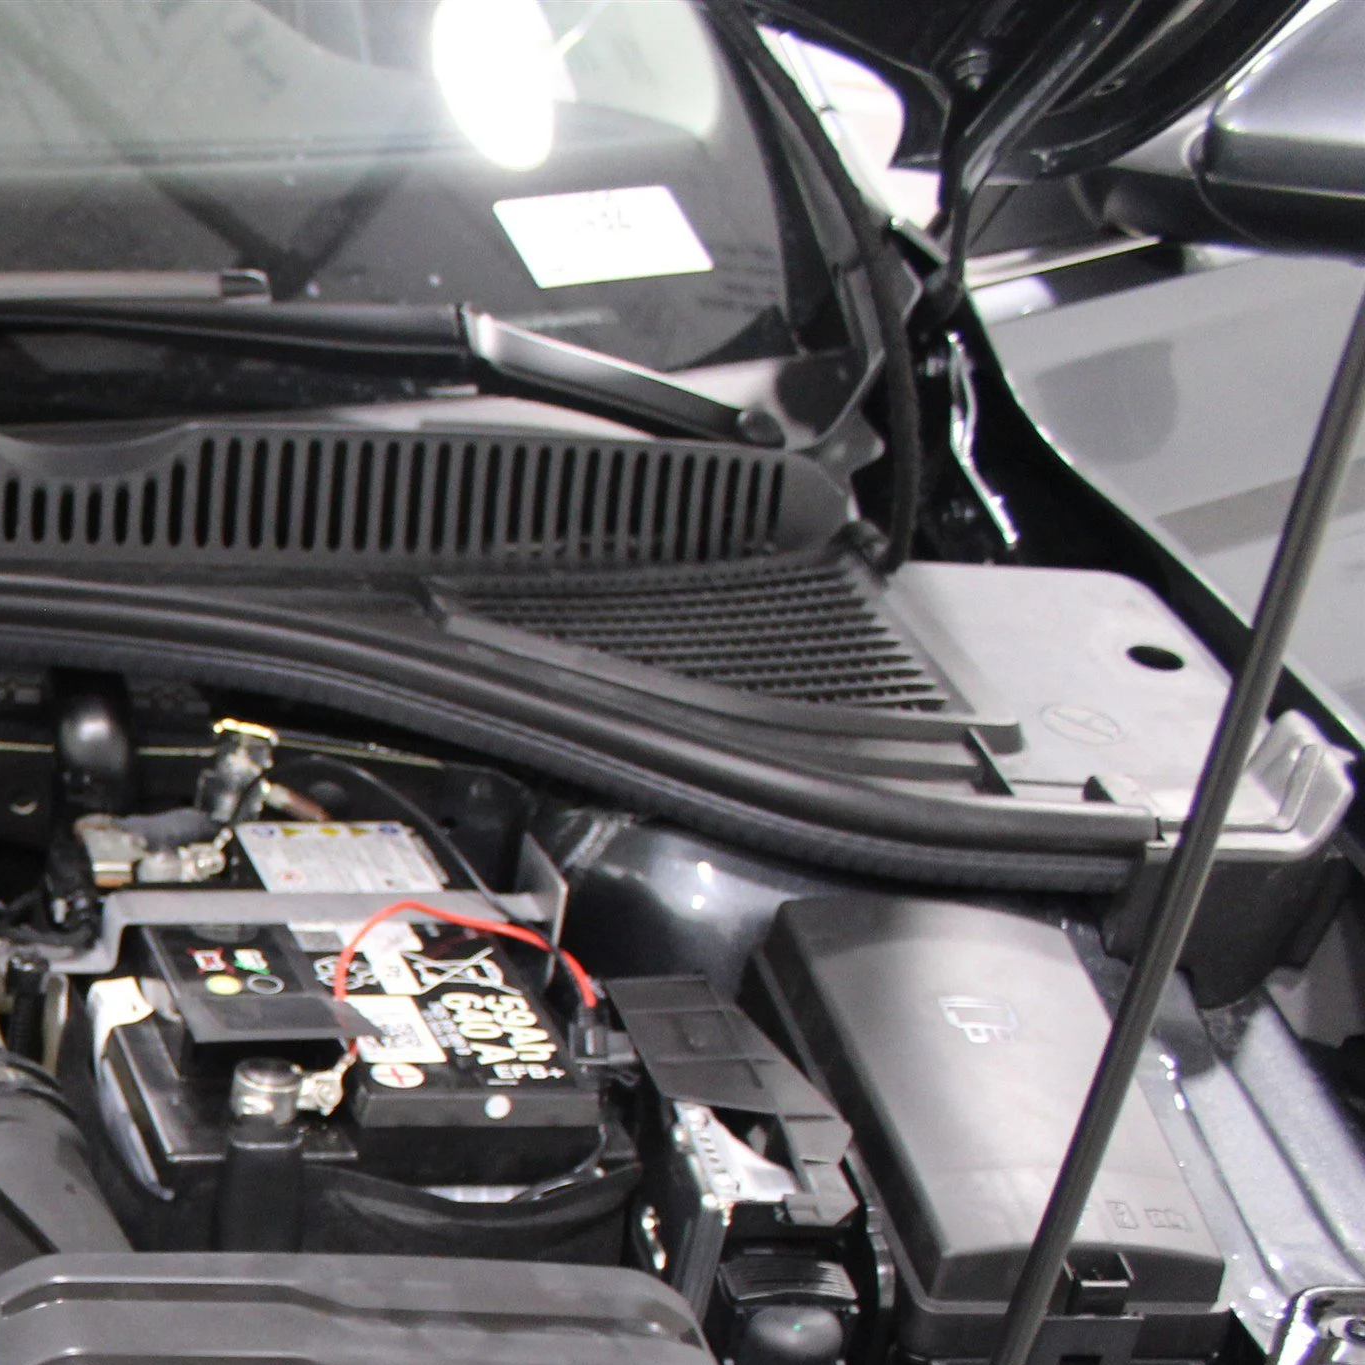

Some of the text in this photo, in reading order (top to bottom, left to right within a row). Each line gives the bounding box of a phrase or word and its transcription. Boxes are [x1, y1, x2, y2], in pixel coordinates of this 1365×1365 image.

[440, 991, 504, 1040] 640
[484, 993, 557, 1062] 59Ah
[471, 1042, 518, 1065] A
